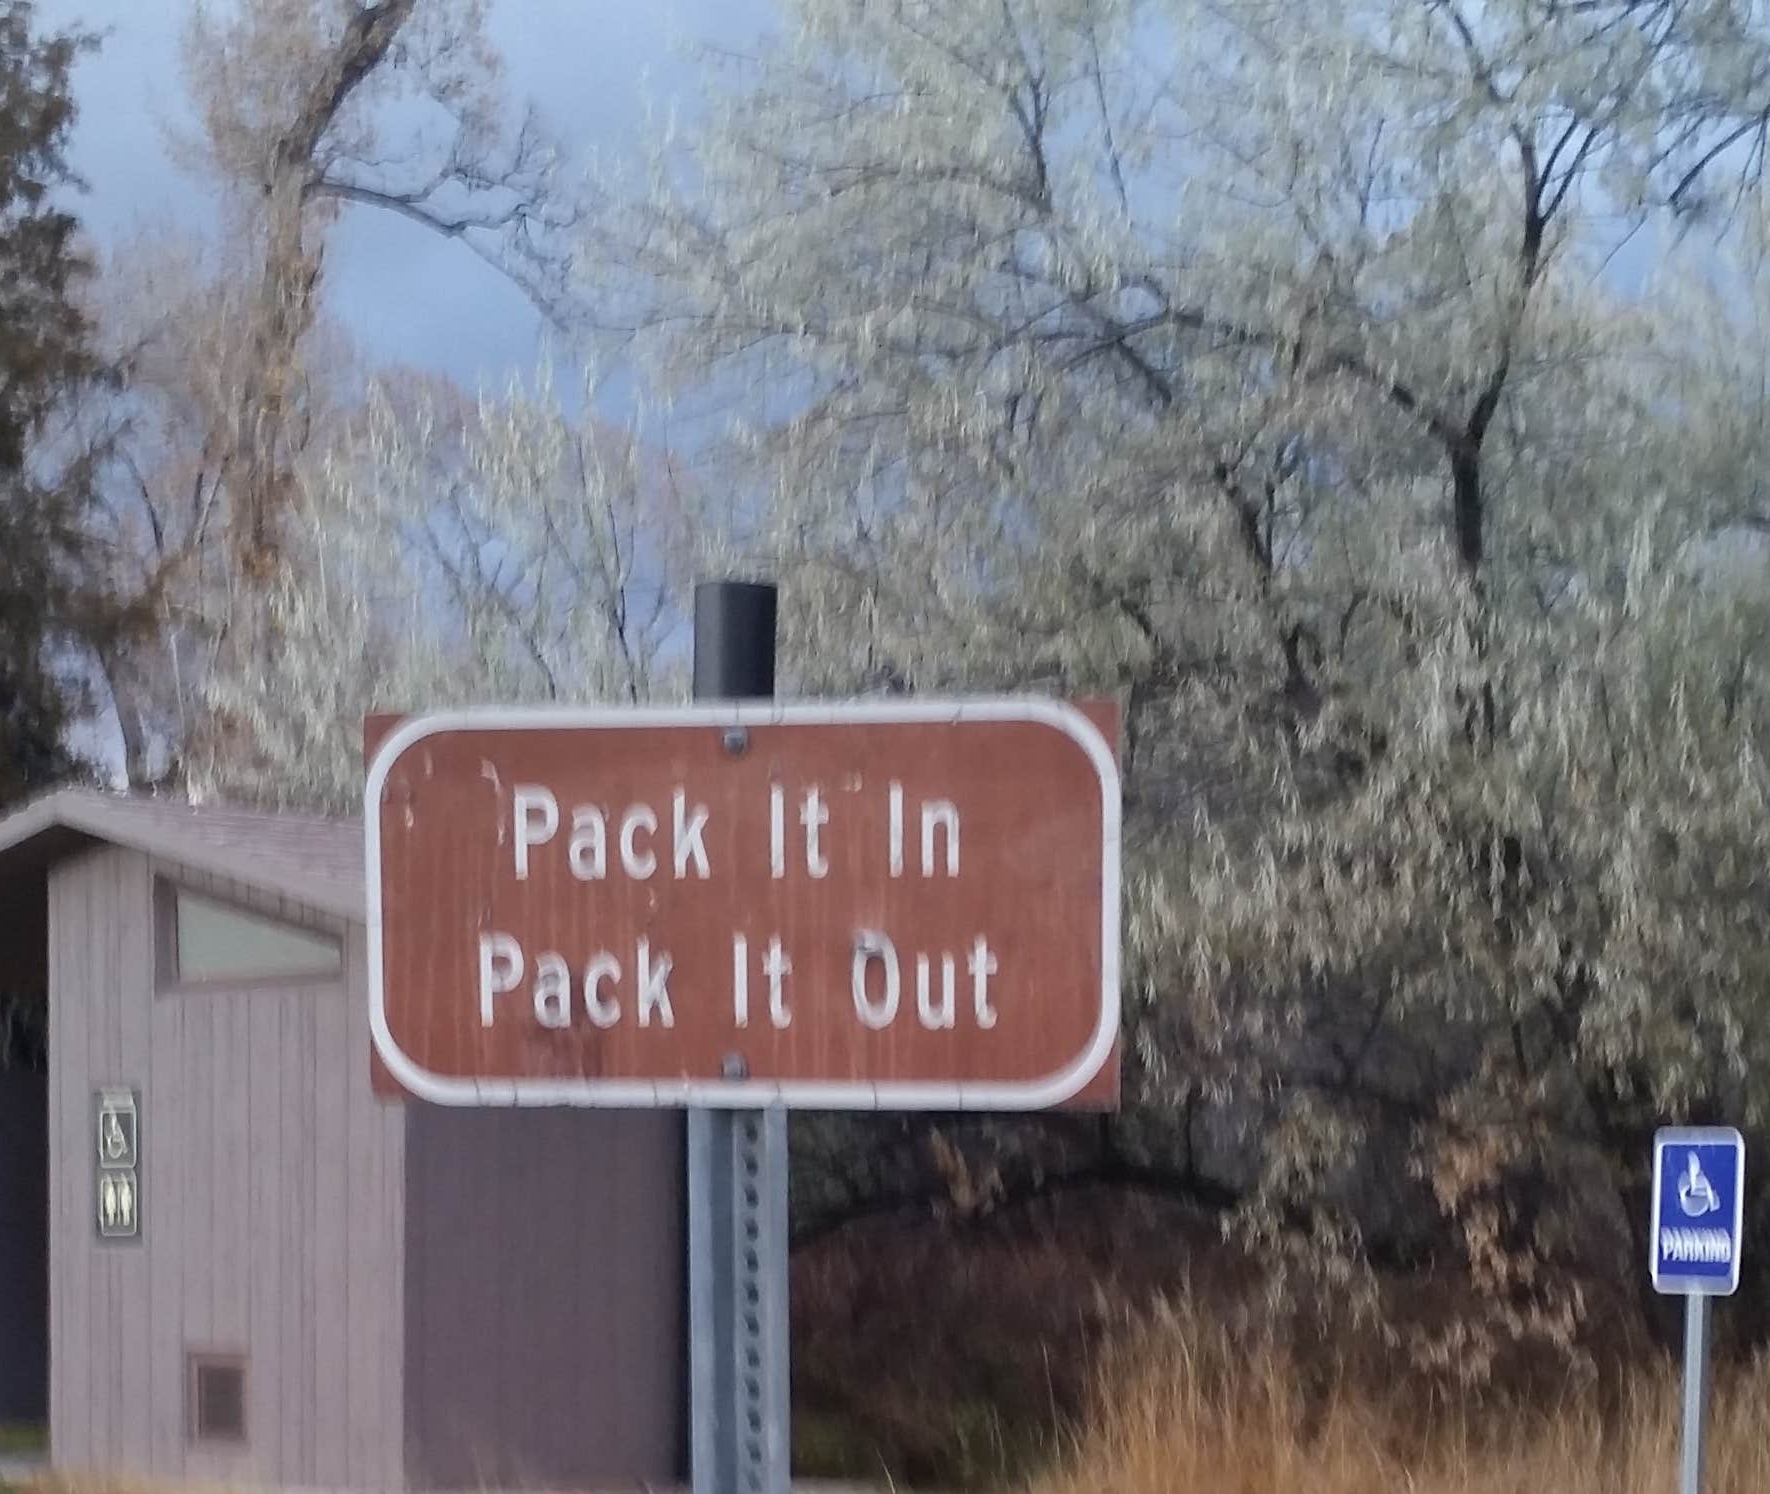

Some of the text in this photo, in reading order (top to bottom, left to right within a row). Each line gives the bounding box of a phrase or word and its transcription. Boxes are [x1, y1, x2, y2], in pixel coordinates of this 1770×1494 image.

[513, 780, 960, 881] Pack It In
[479, 929, 998, 1030] Pack It Out
[1660, 1227, 1732, 1263] PARKING
